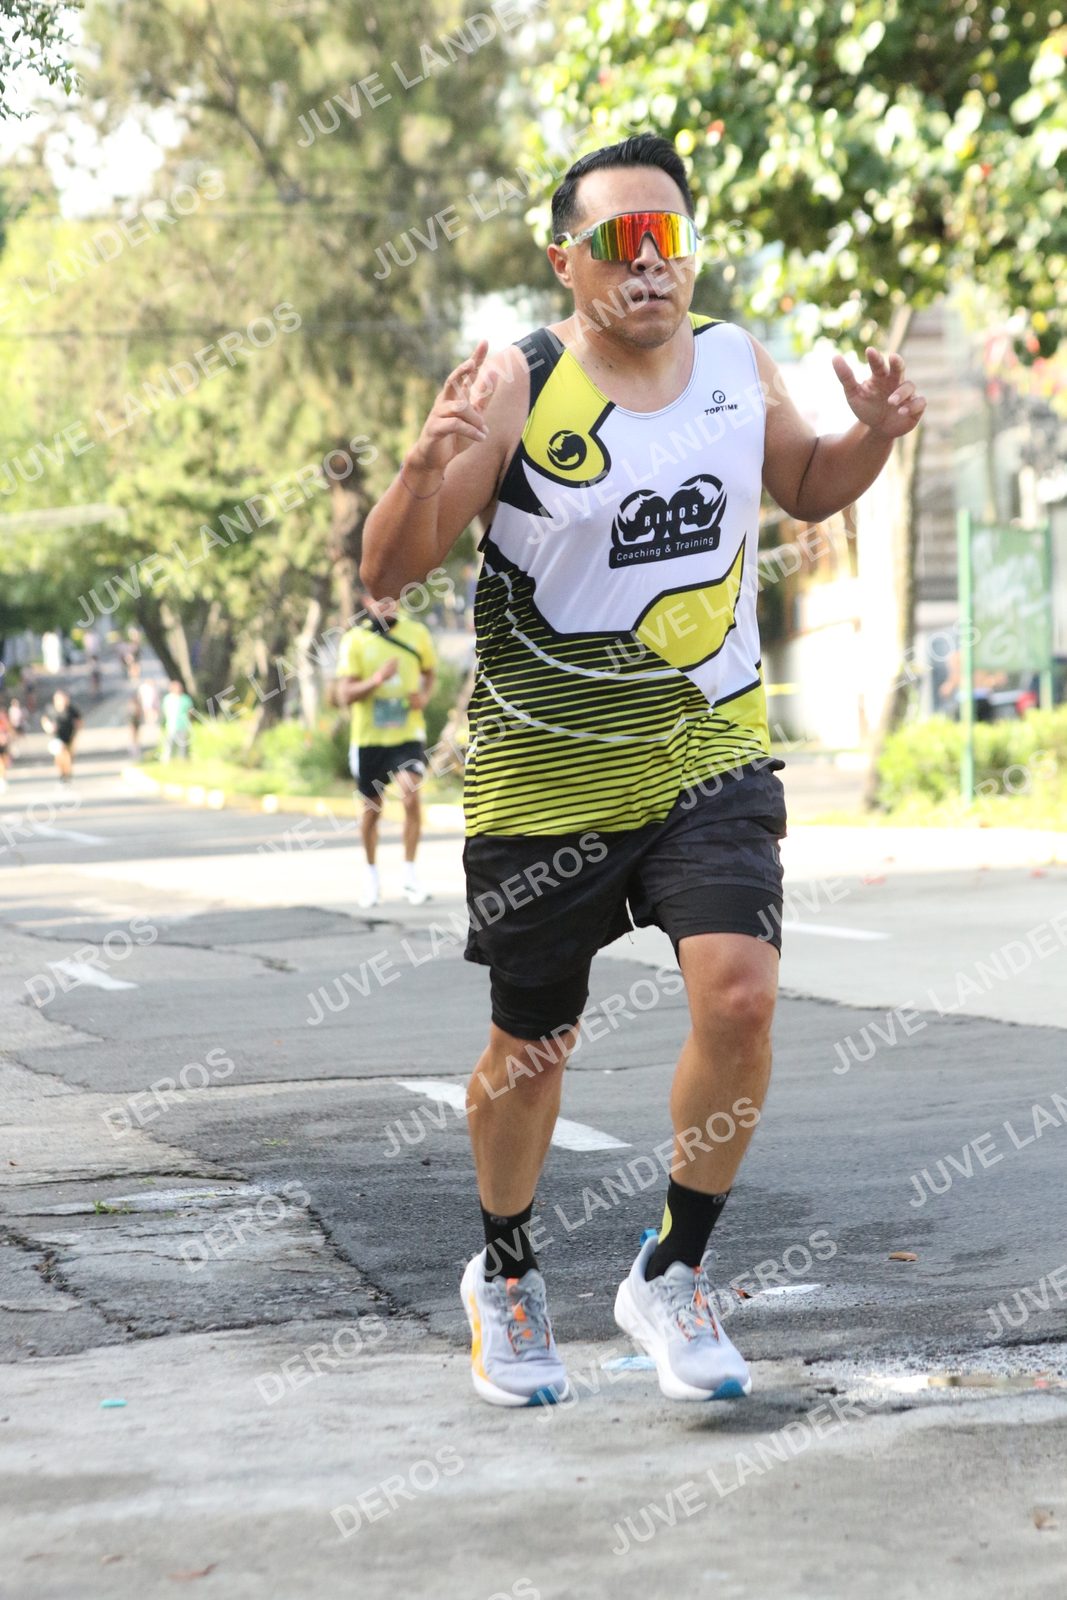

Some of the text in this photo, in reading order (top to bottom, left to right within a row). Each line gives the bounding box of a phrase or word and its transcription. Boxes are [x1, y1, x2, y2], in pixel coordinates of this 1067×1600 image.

[644, 504, 699, 527] RINOS
[616, 537, 714, 561] Coaching & Training
